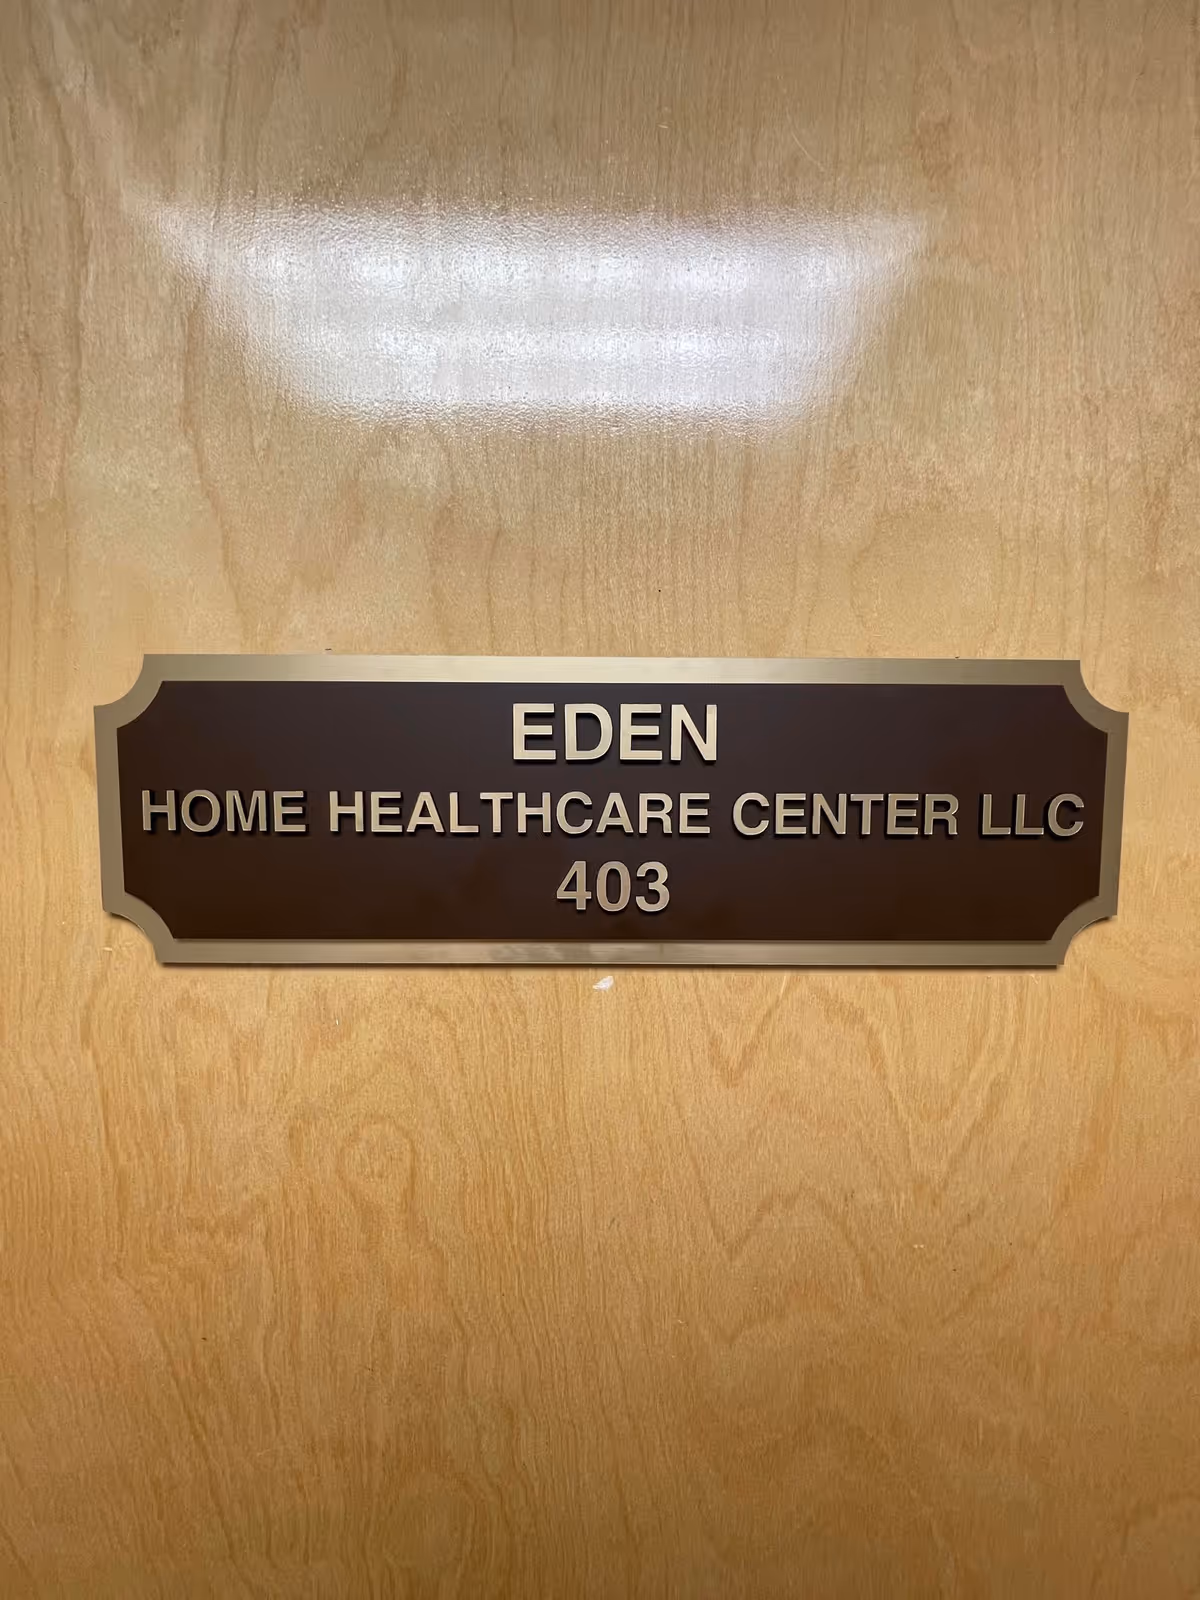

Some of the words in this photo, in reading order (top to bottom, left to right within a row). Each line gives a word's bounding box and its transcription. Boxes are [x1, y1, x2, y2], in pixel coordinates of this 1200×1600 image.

[512, 702, 718, 761] EDEN
[141, 789, 307, 833] HOME
[329, 790, 711, 835] HEALTHCARE
[732, 792, 959, 836] CENTER
[981, 793, 1085, 837] LLC
[556, 860, 670, 912] 403
